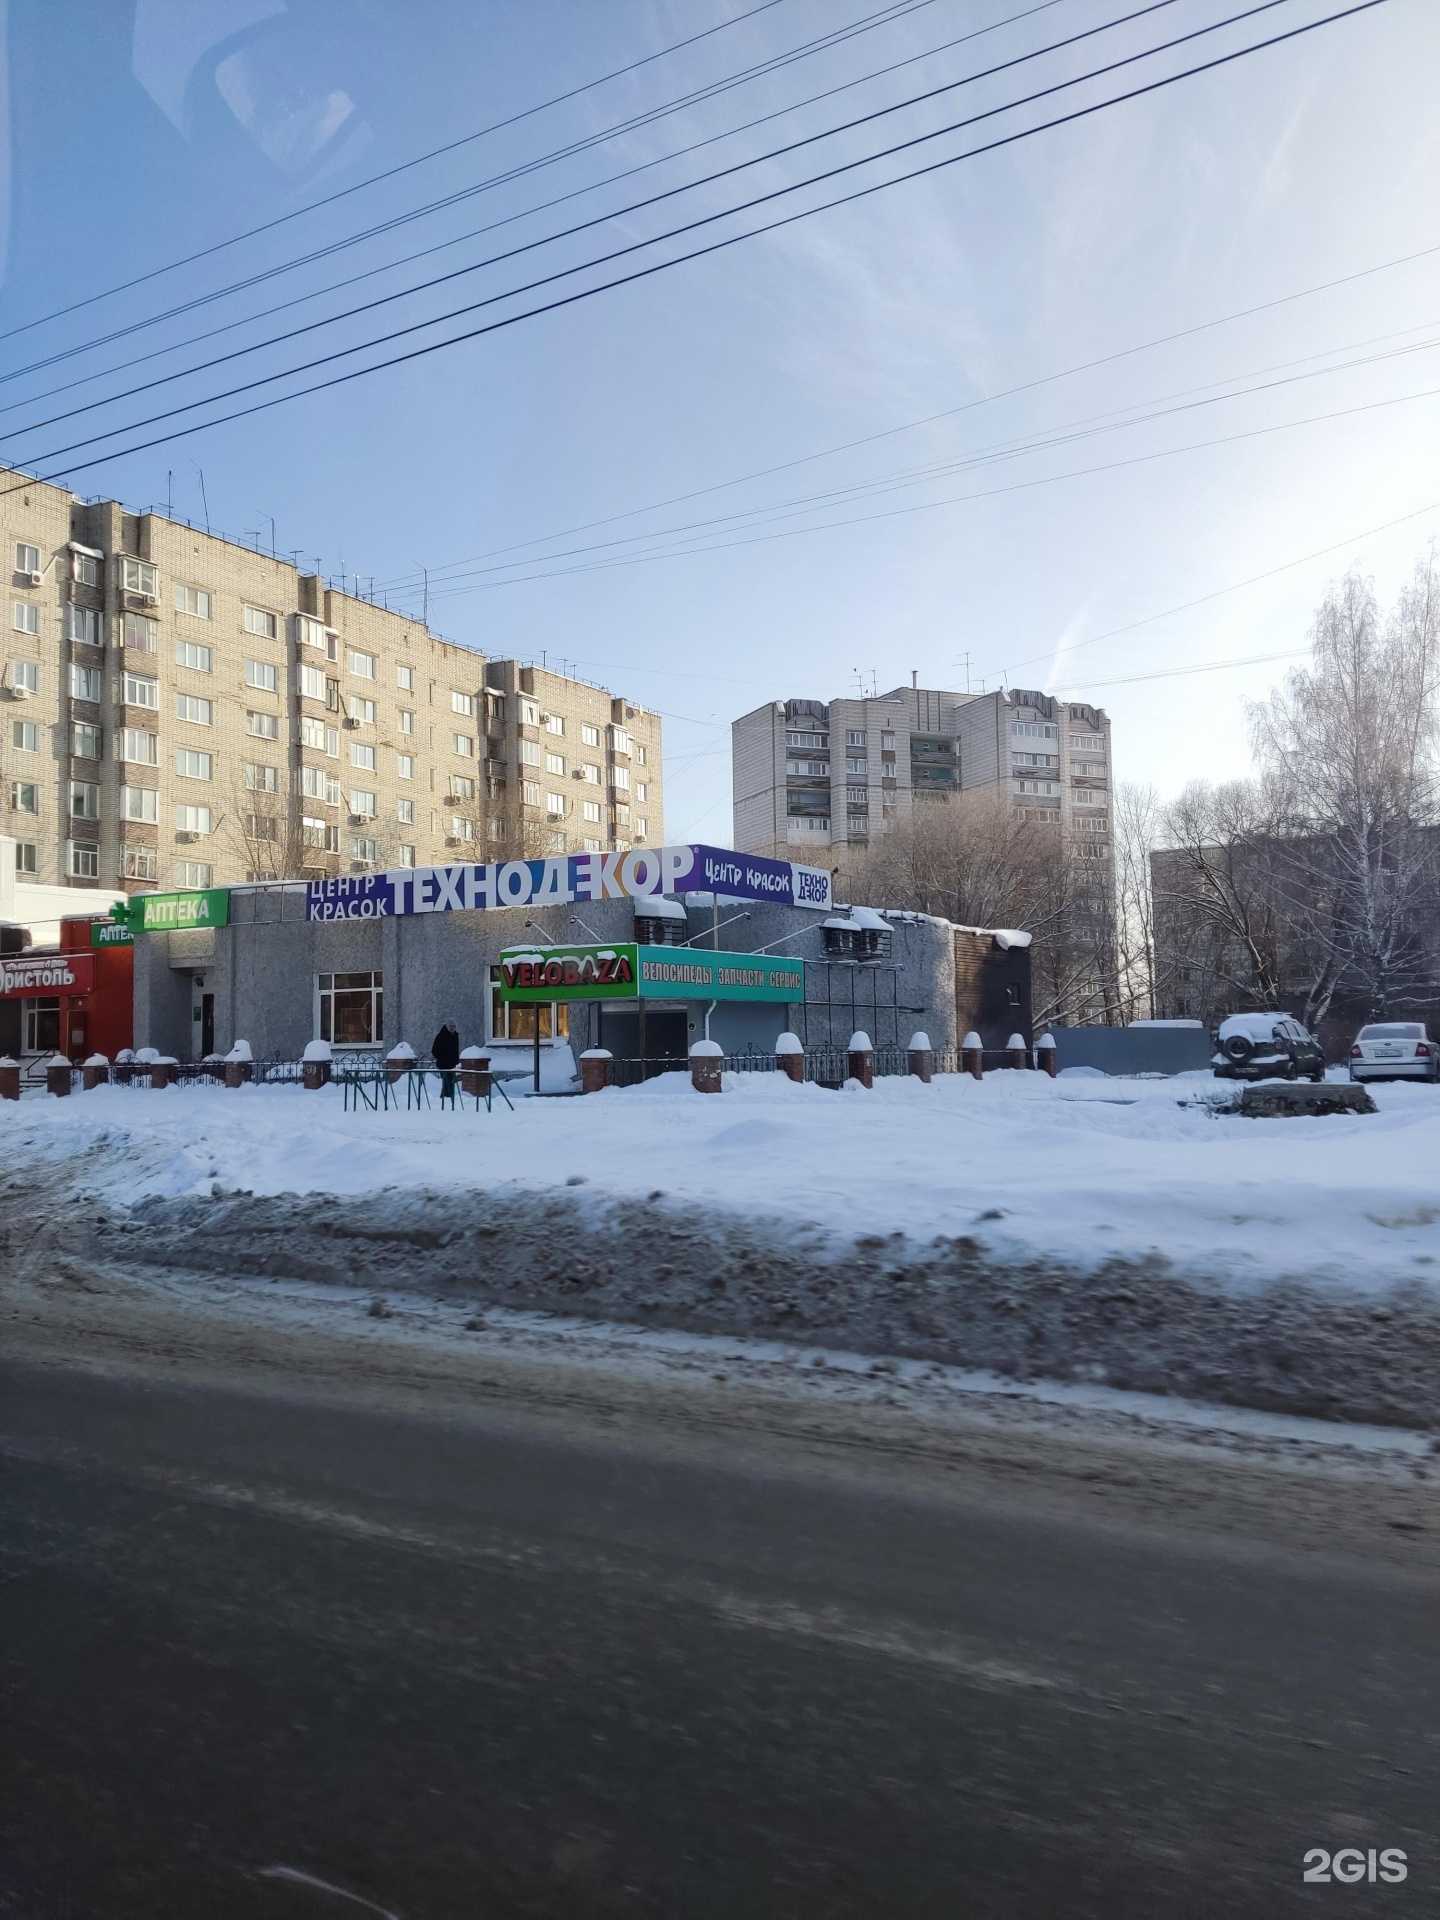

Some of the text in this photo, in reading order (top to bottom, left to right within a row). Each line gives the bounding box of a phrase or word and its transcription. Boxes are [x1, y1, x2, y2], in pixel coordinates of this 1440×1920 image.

[311, 875, 376, 902] ЦЕНТР
[386, 845, 695, 915] ТЕХНОДЕКОР
[798, 872, 829, 890] ТЕХНО
[798, 886, 828, 903] ДЕКОР
[144, 899, 209, 923] АПТЕКА
[310, 897, 388, 921] КРАСОК
[502, 958, 632, 988] VELOBAZA
[642, 961, 801, 989] ВЕЛОСИПЕДЫ ЗАПЧАСТИ СЕРВИС
